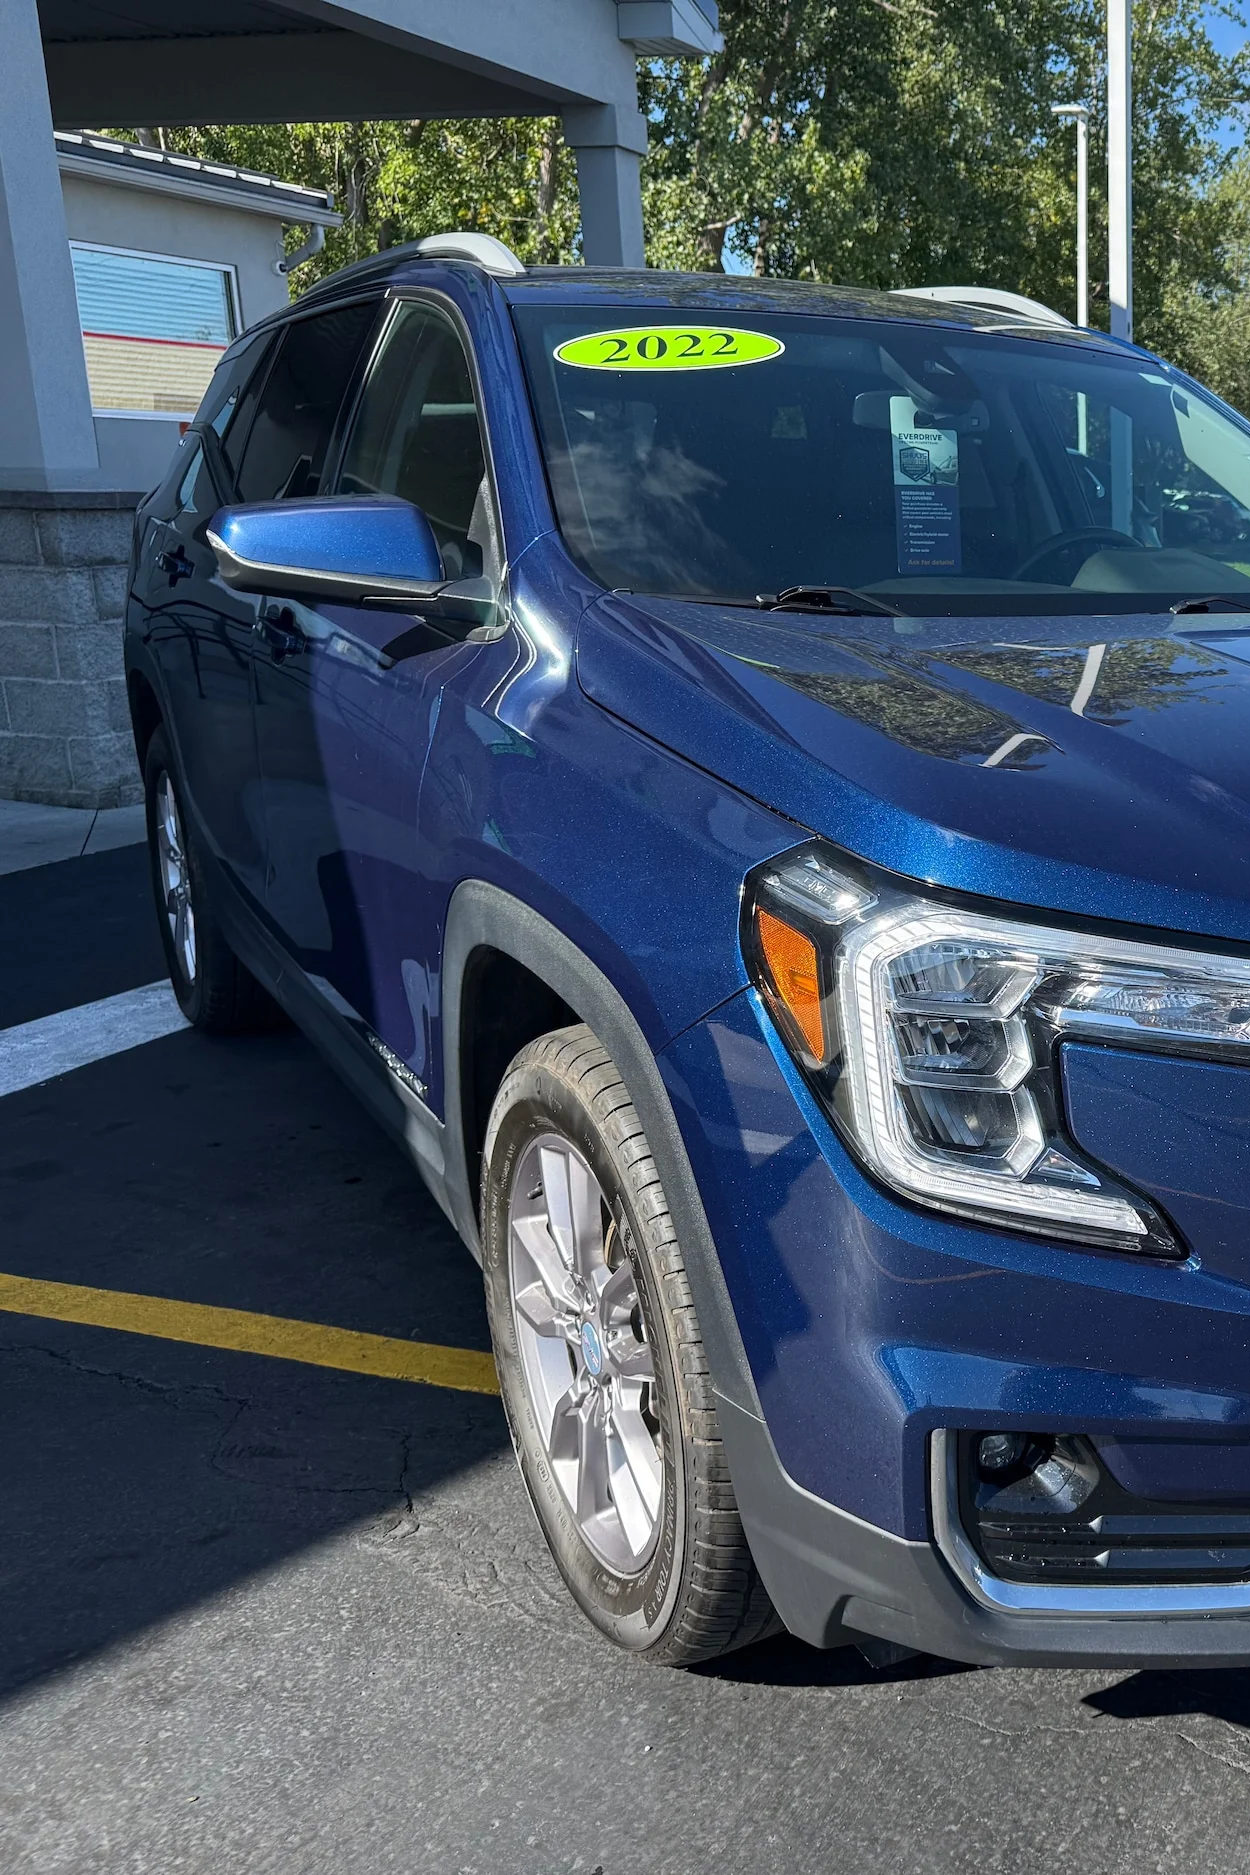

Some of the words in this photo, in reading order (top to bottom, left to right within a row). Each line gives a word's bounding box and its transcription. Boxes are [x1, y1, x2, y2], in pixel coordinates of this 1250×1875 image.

[599, 332, 739, 364] 2022
[898, 433, 943, 441] EVERDRIVE
[664, 1478, 676, 1564] PRIMACY
[654, 1562, 669, 1602] TOUR
